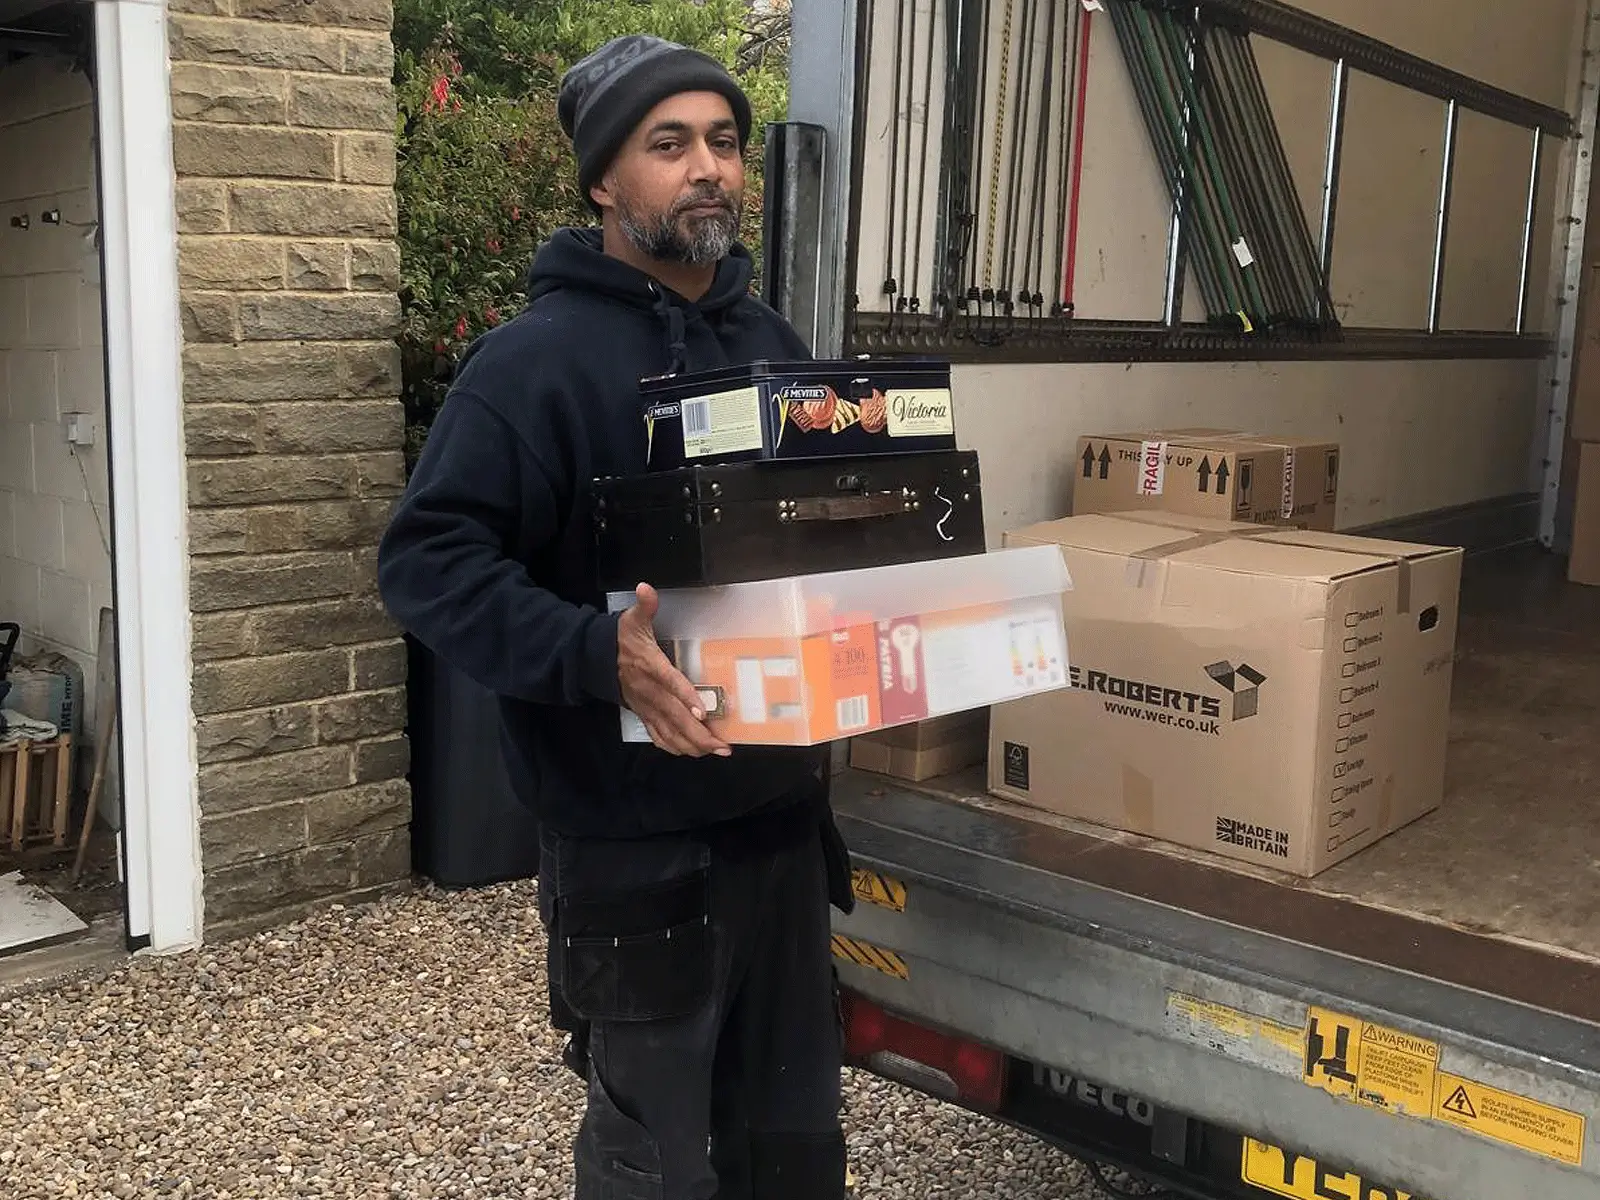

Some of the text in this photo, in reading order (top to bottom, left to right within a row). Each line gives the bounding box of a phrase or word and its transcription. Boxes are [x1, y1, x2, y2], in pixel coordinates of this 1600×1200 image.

[892, 395, 947, 422] Victoria
[1177, 456, 1193, 467] UP
[1104, 701, 1220, 736] www.wer.co.uk
[1236, 821, 1289, 844] MADE IN
[1236, 834, 1288, 857] BRITAIN
[1378, 1030, 1436, 1057] WARNING
[1033, 1062, 1154, 1126] IVECO
